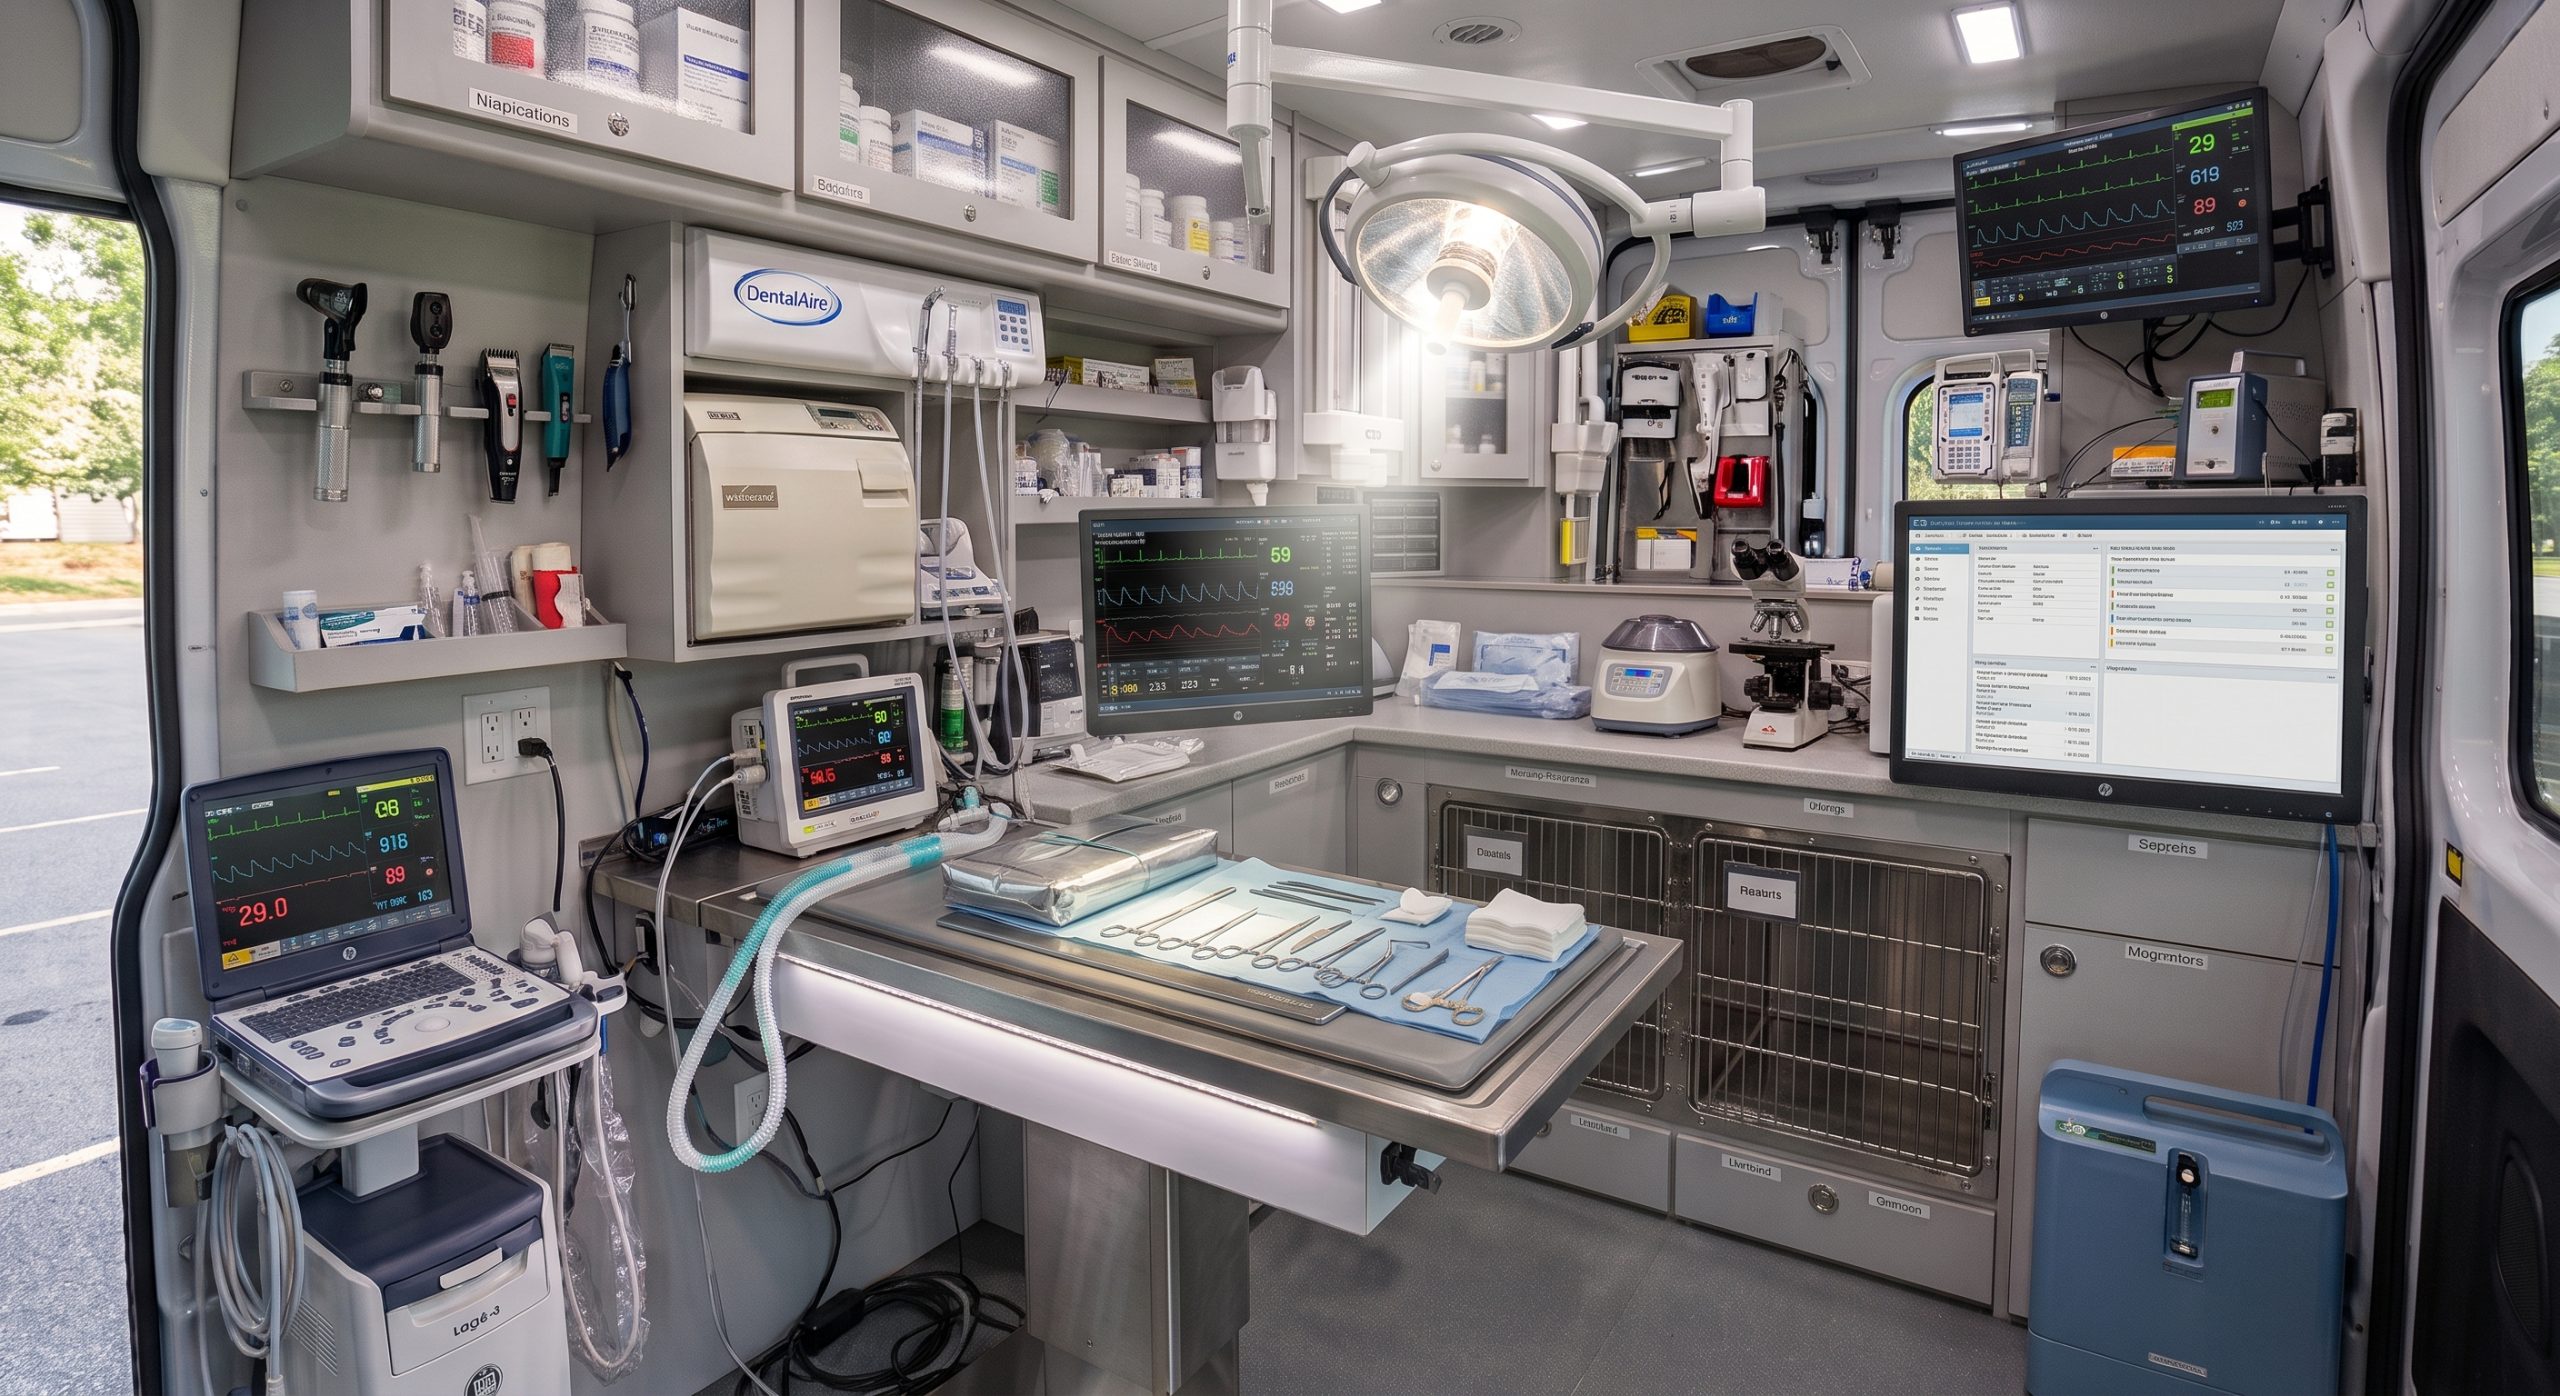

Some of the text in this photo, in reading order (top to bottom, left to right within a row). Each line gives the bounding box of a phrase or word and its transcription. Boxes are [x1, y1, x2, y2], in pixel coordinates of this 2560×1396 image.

[476, 93, 571, 128] Niapications
[2189, 133, 2215, 155] 29
[2193, 197, 2216, 215] 89
[747, 284, 829, 312] DentalAire
[1270, 546, 1291, 563] 59
[385, 865, 406, 885] 89
[238, 896, 288, 928] 29.0
